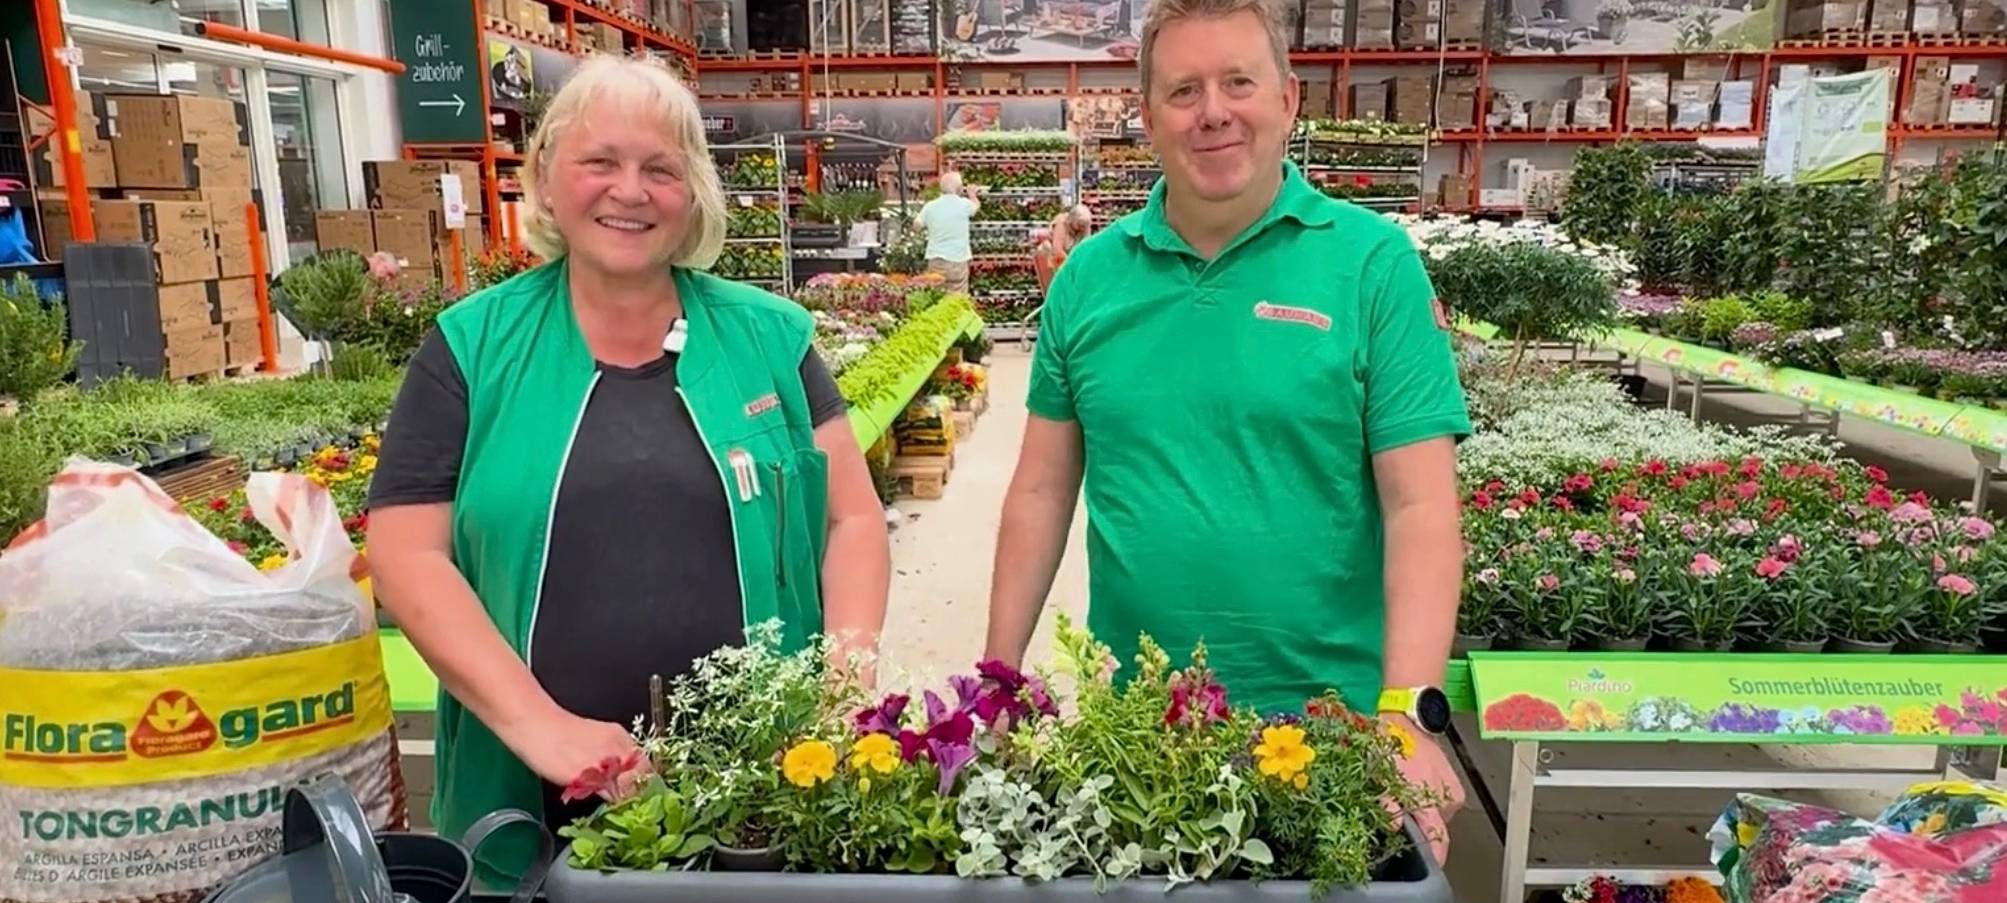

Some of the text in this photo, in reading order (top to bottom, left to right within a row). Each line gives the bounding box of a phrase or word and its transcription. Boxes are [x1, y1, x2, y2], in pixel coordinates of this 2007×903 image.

[415, 34, 450, 57] Grill-
[412, 61, 464, 82] zubehör
[1728, 677, 1944, 697] Sommerblütenzauber
[5, 681, 355, 754] Flora gard
[19, 771, 333, 842] TONGRANUL
[82, 849, 154, 866] ESPANSA
[176, 834, 241, 856] ARCILLA
